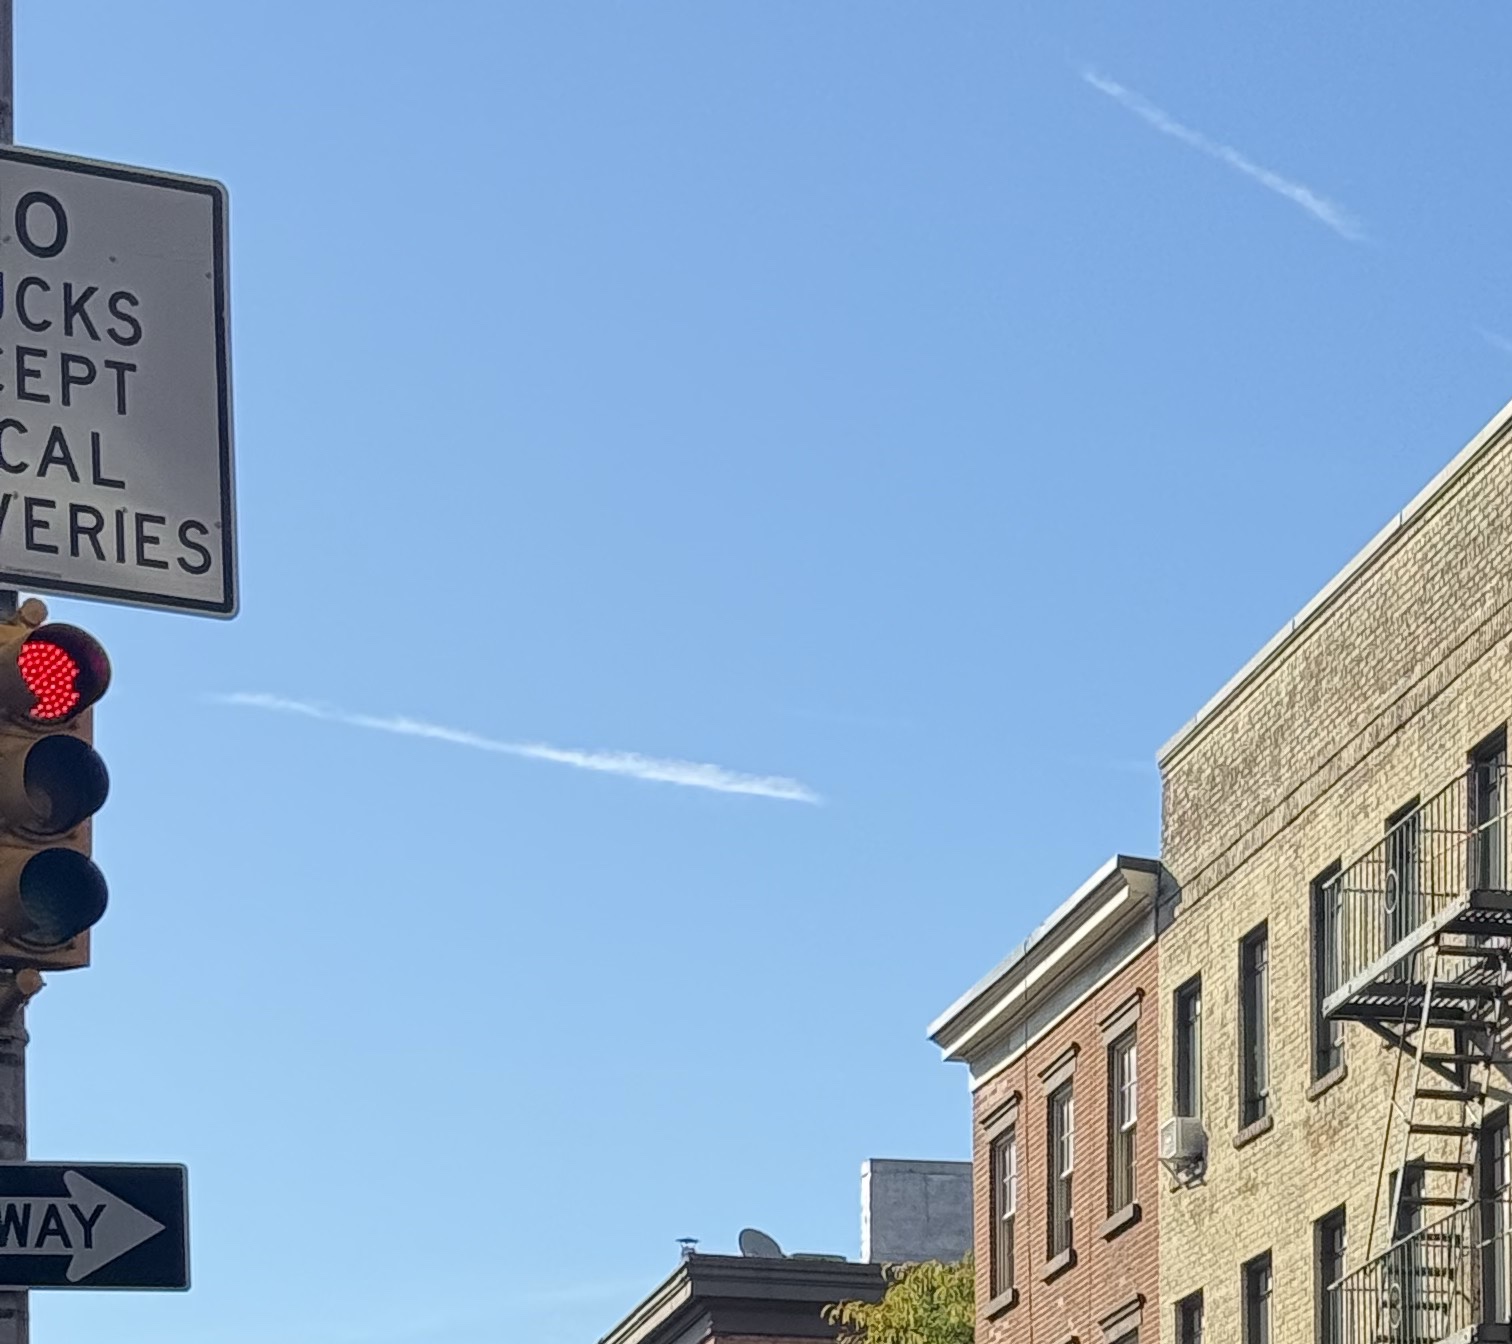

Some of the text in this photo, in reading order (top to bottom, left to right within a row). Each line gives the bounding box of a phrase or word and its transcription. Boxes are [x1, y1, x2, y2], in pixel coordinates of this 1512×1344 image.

[0, 272, 143, 347] CKS
[0, 346, 138, 416] EPT
[0, 1203, 107, 1250] WAY
